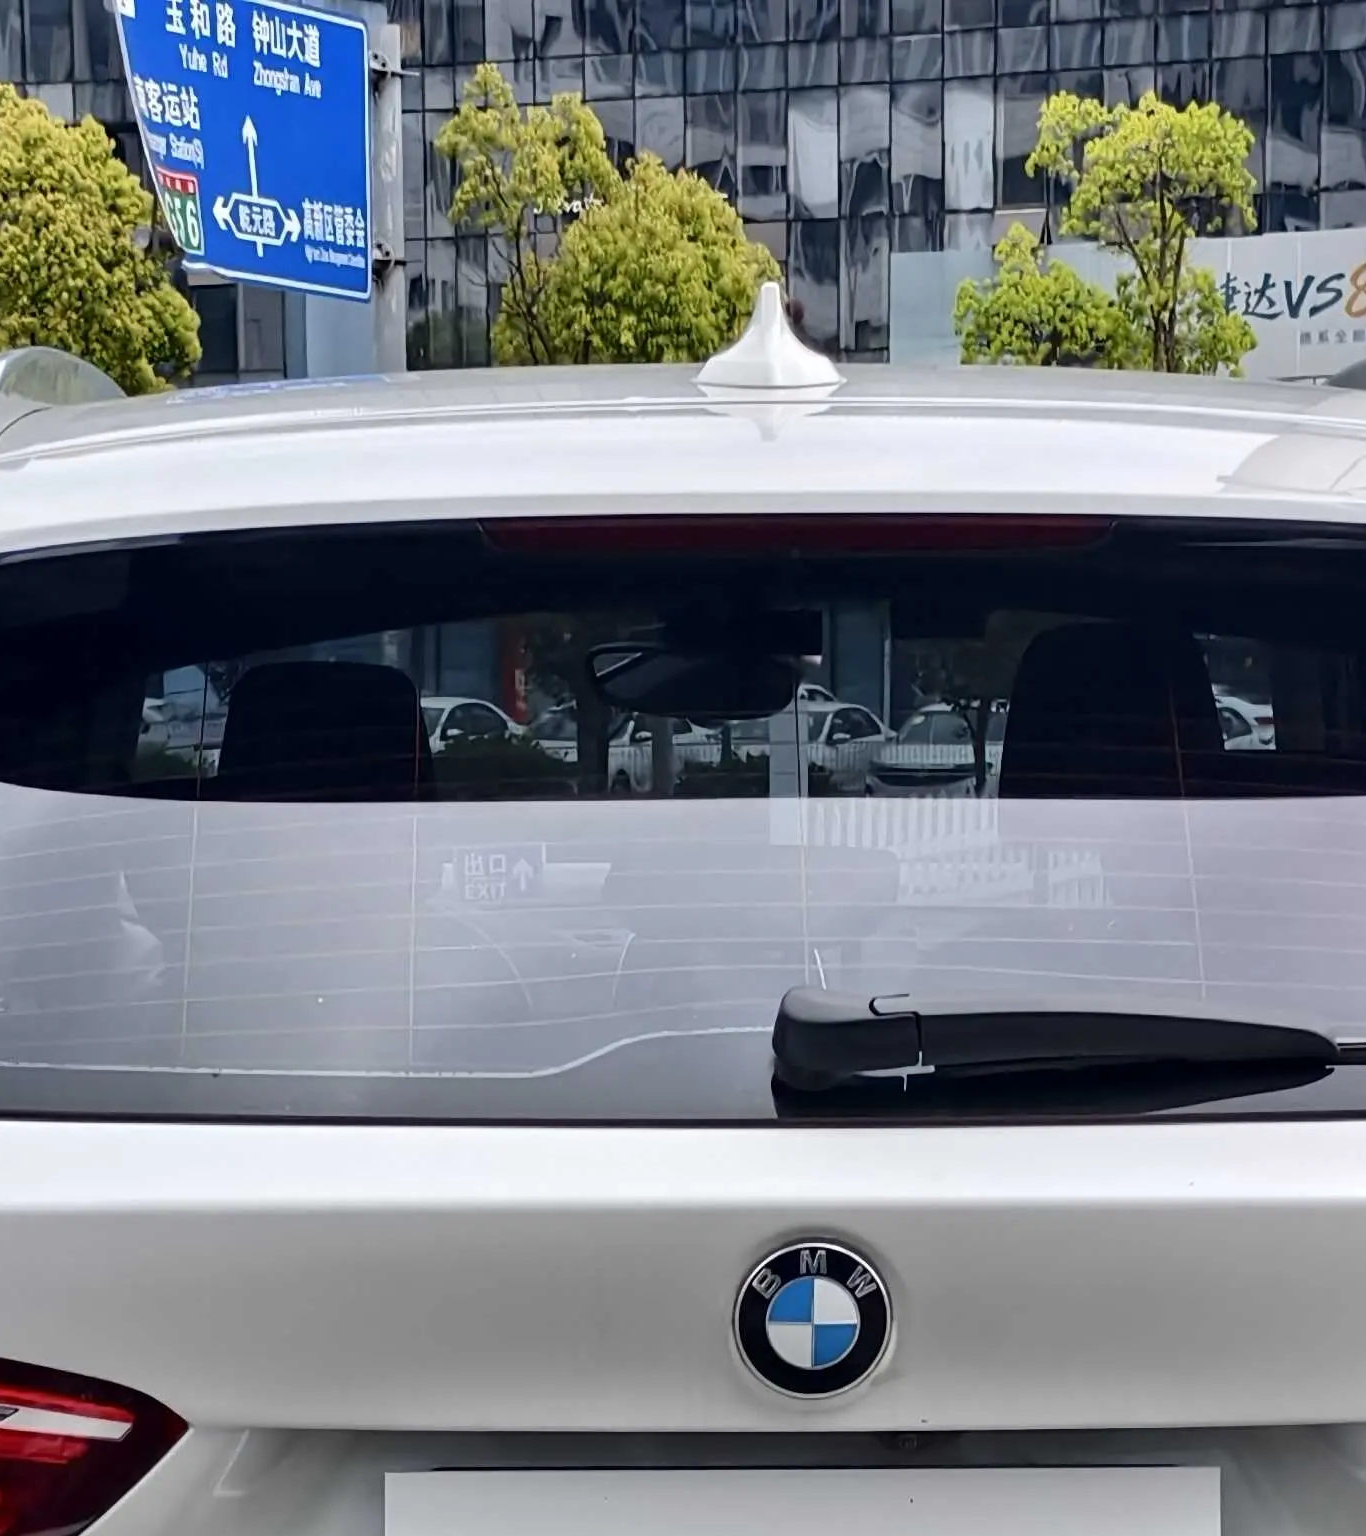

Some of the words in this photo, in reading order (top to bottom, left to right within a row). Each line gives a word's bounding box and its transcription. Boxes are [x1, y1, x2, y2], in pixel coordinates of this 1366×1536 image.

[165, 0, 235, 47] 玉和路
[252, 10, 321, 67] 钟山大道
[464, 853, 506, 875] 出口
[464, 883, 506, 900] EXIT
[752, 1249, 877, 1299] BMW
